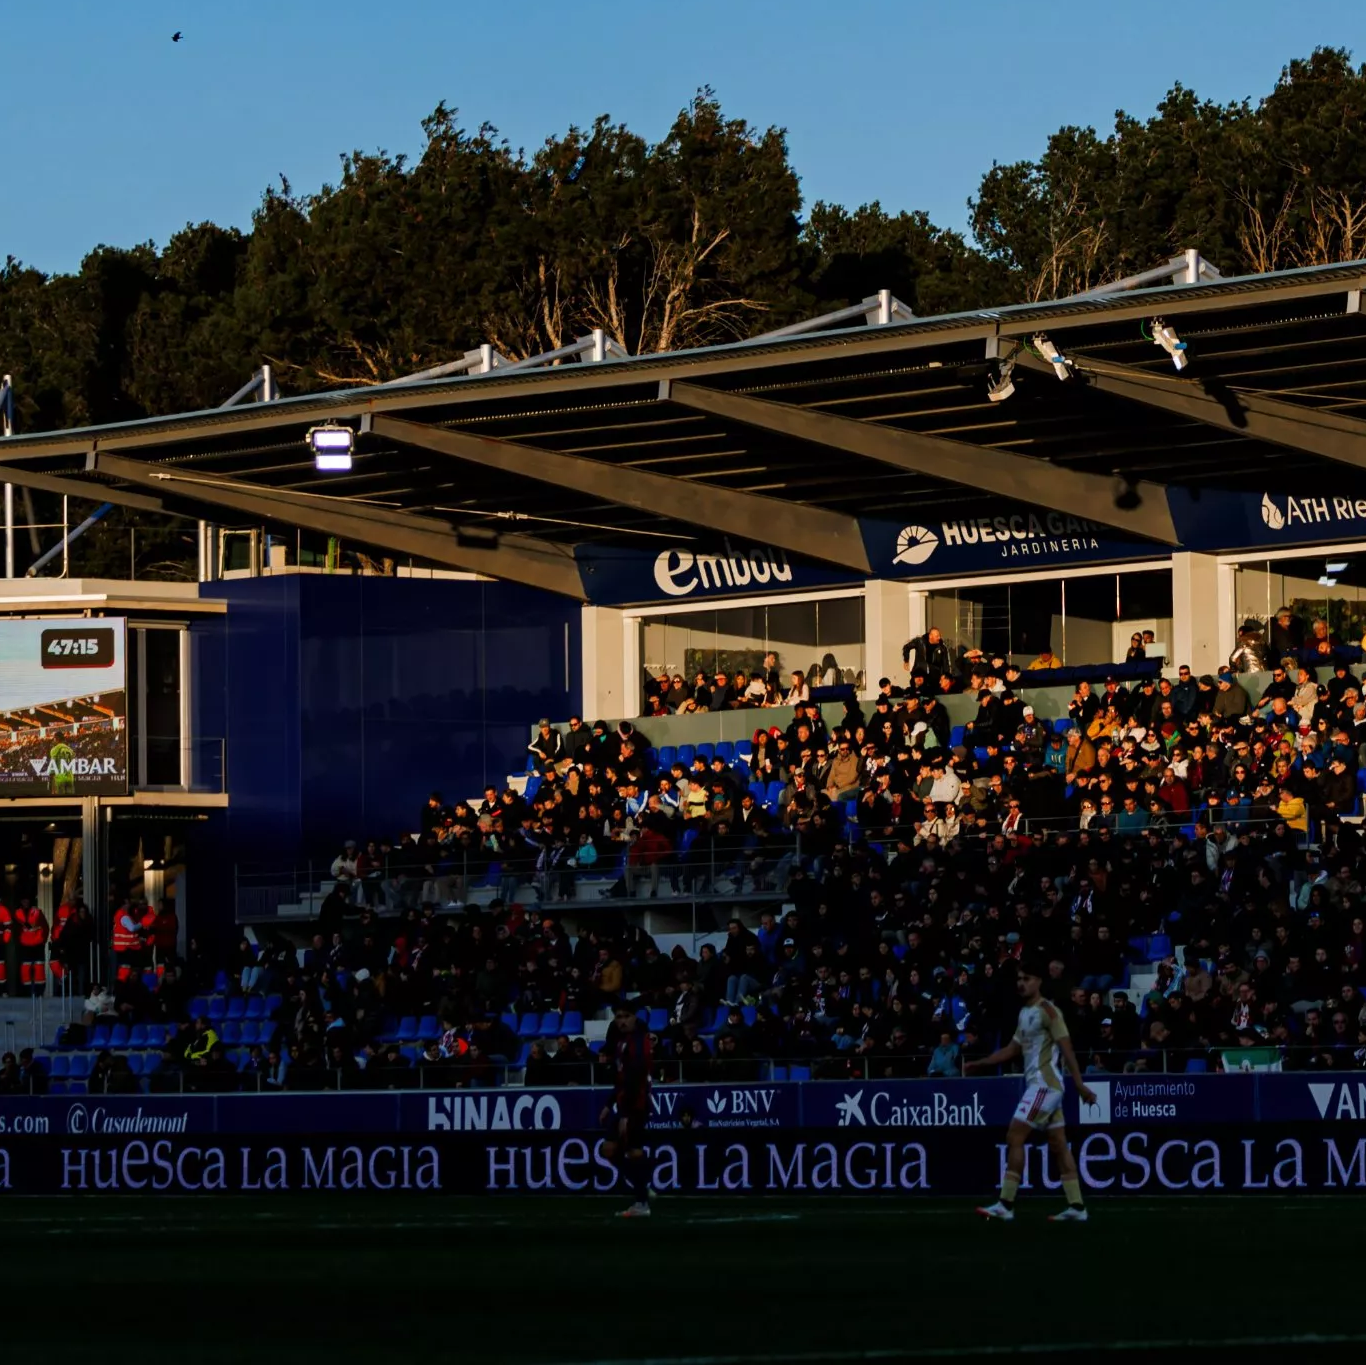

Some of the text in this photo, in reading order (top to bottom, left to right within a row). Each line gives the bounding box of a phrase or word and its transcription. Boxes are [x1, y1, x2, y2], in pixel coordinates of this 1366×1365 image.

[1287, 495, 1330, 525] ATH
[941, 512, 1046, 546] HUESCA
[1001, 538, 1099, 558] JARDINERIA
[653, 535, 793, 596] embou
[47, 638, 99, 656] 47:15
[46, 757, 119, 775] AMBAR
[731, 1089, 775, 1114] BNV
[1114, 1081, 1195, 1101] Ayuntamiento
[92, 1106, 188, 1134] Casademont
[869, 1090, 987, 1127] CaixaBank
[1114, 1102, 1177, 1118] de Huesca
